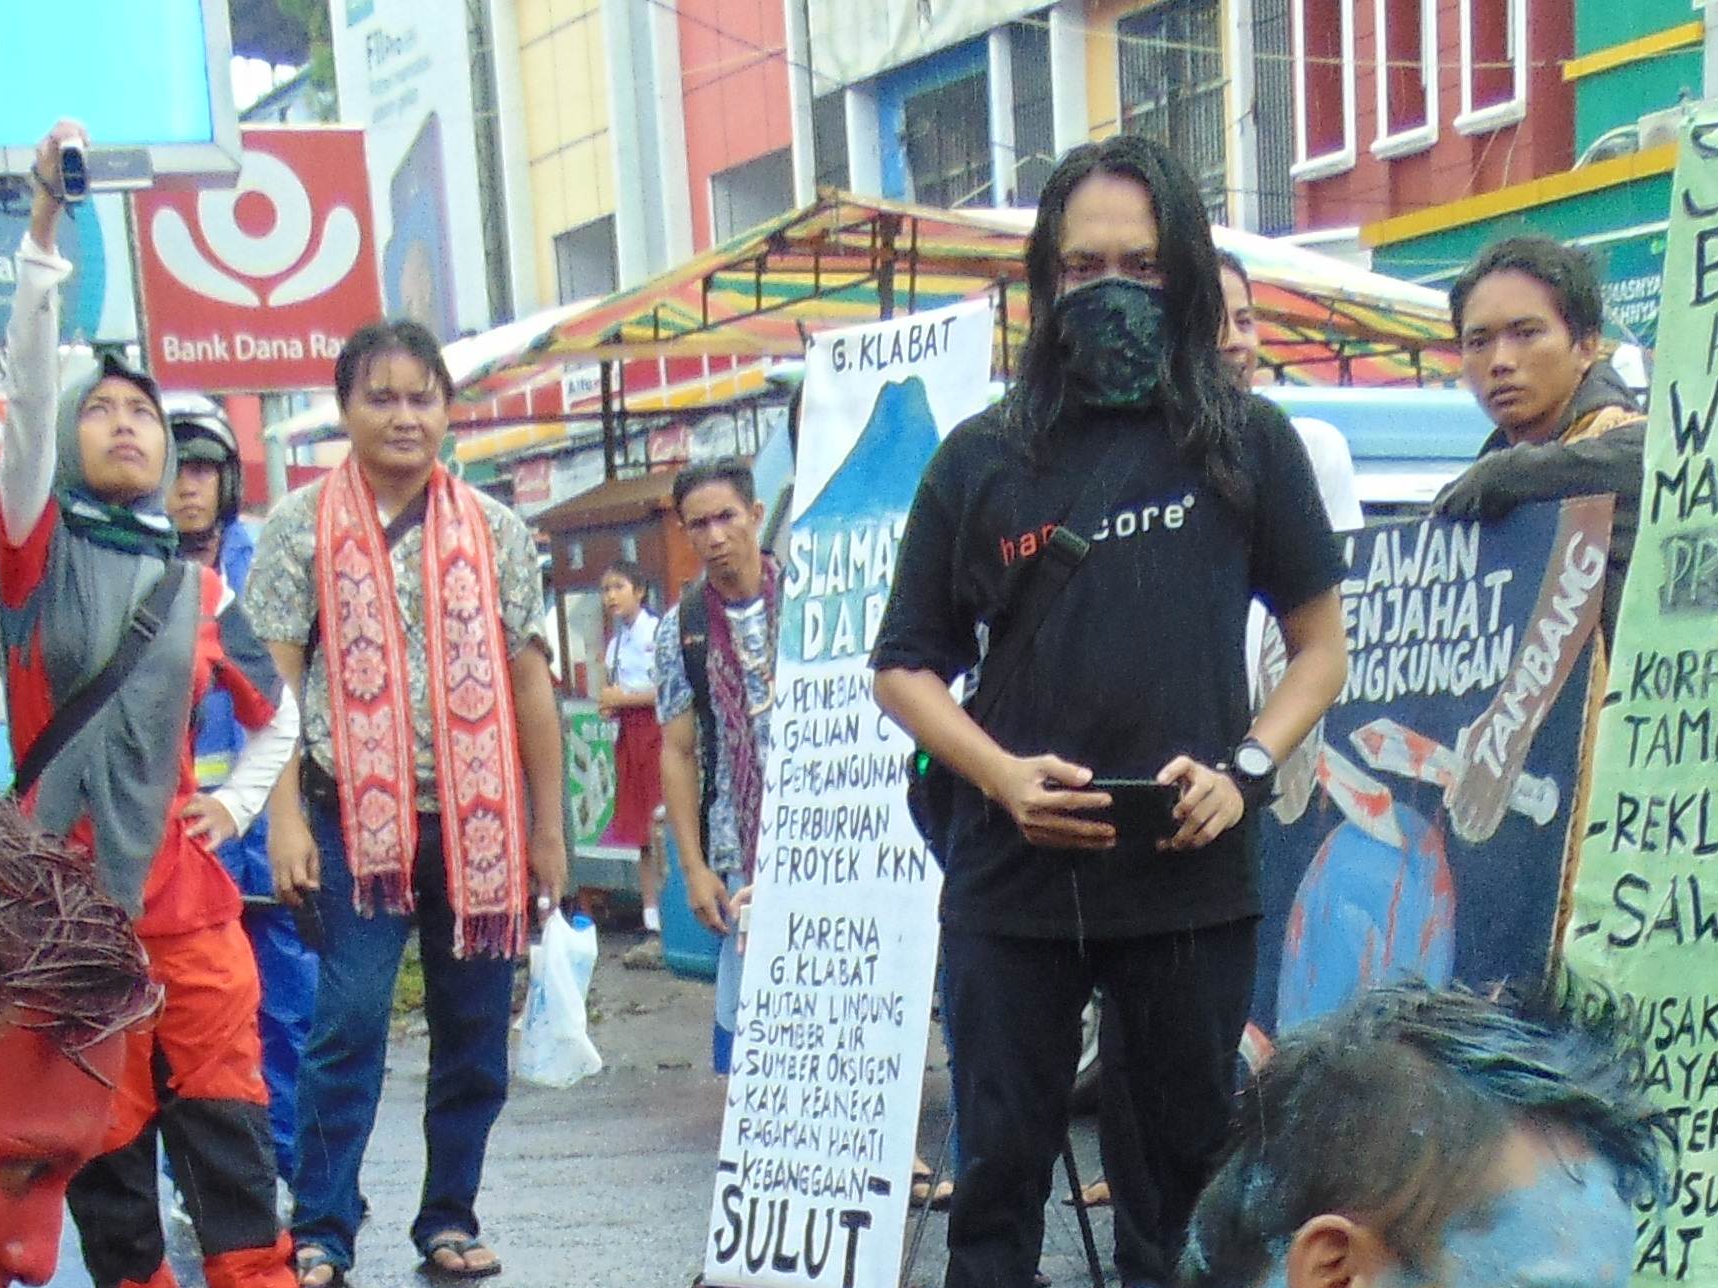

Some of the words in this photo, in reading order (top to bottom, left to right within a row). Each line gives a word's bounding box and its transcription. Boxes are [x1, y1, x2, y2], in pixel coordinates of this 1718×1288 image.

[163, 334, 229, 362] Bank
[235, 333, 303, 360] Dana
[860, 317, 957, 371] KLABAT
[1340, 570, 1513, 650] ENJAHAT
[1473, 531, 1607, 779] TAMBANG
[784, 713, 860, 752] GALIAN
[774, 846, 860, 885] PROYEK
[877, 843, 927, 883] KKN
[788, 912, 880, 952] KARENA
[796, 953, 878, 986] KLABAT
[756, 988, 817, 1019] HUTAN
[829, 991, 904, 1026] LINDUNG
[749, 1019, 824, 1050] SUMBER
[837, 1026, 865, 1050] AIR
[746, 1049, 820, 1083] SUMBER
[827, 1052, 901, 1086] OKSIGEN
[744, 1084, 788, 1114] KAYA
[801, 1085, 885, 1122] KEANEKA
[738, 1117, 821, 1151] RAGAMAN
[829, 1126, 884, 1162] HAYATI
[741, 1150, 868, 1203] KEBANGGAAN
